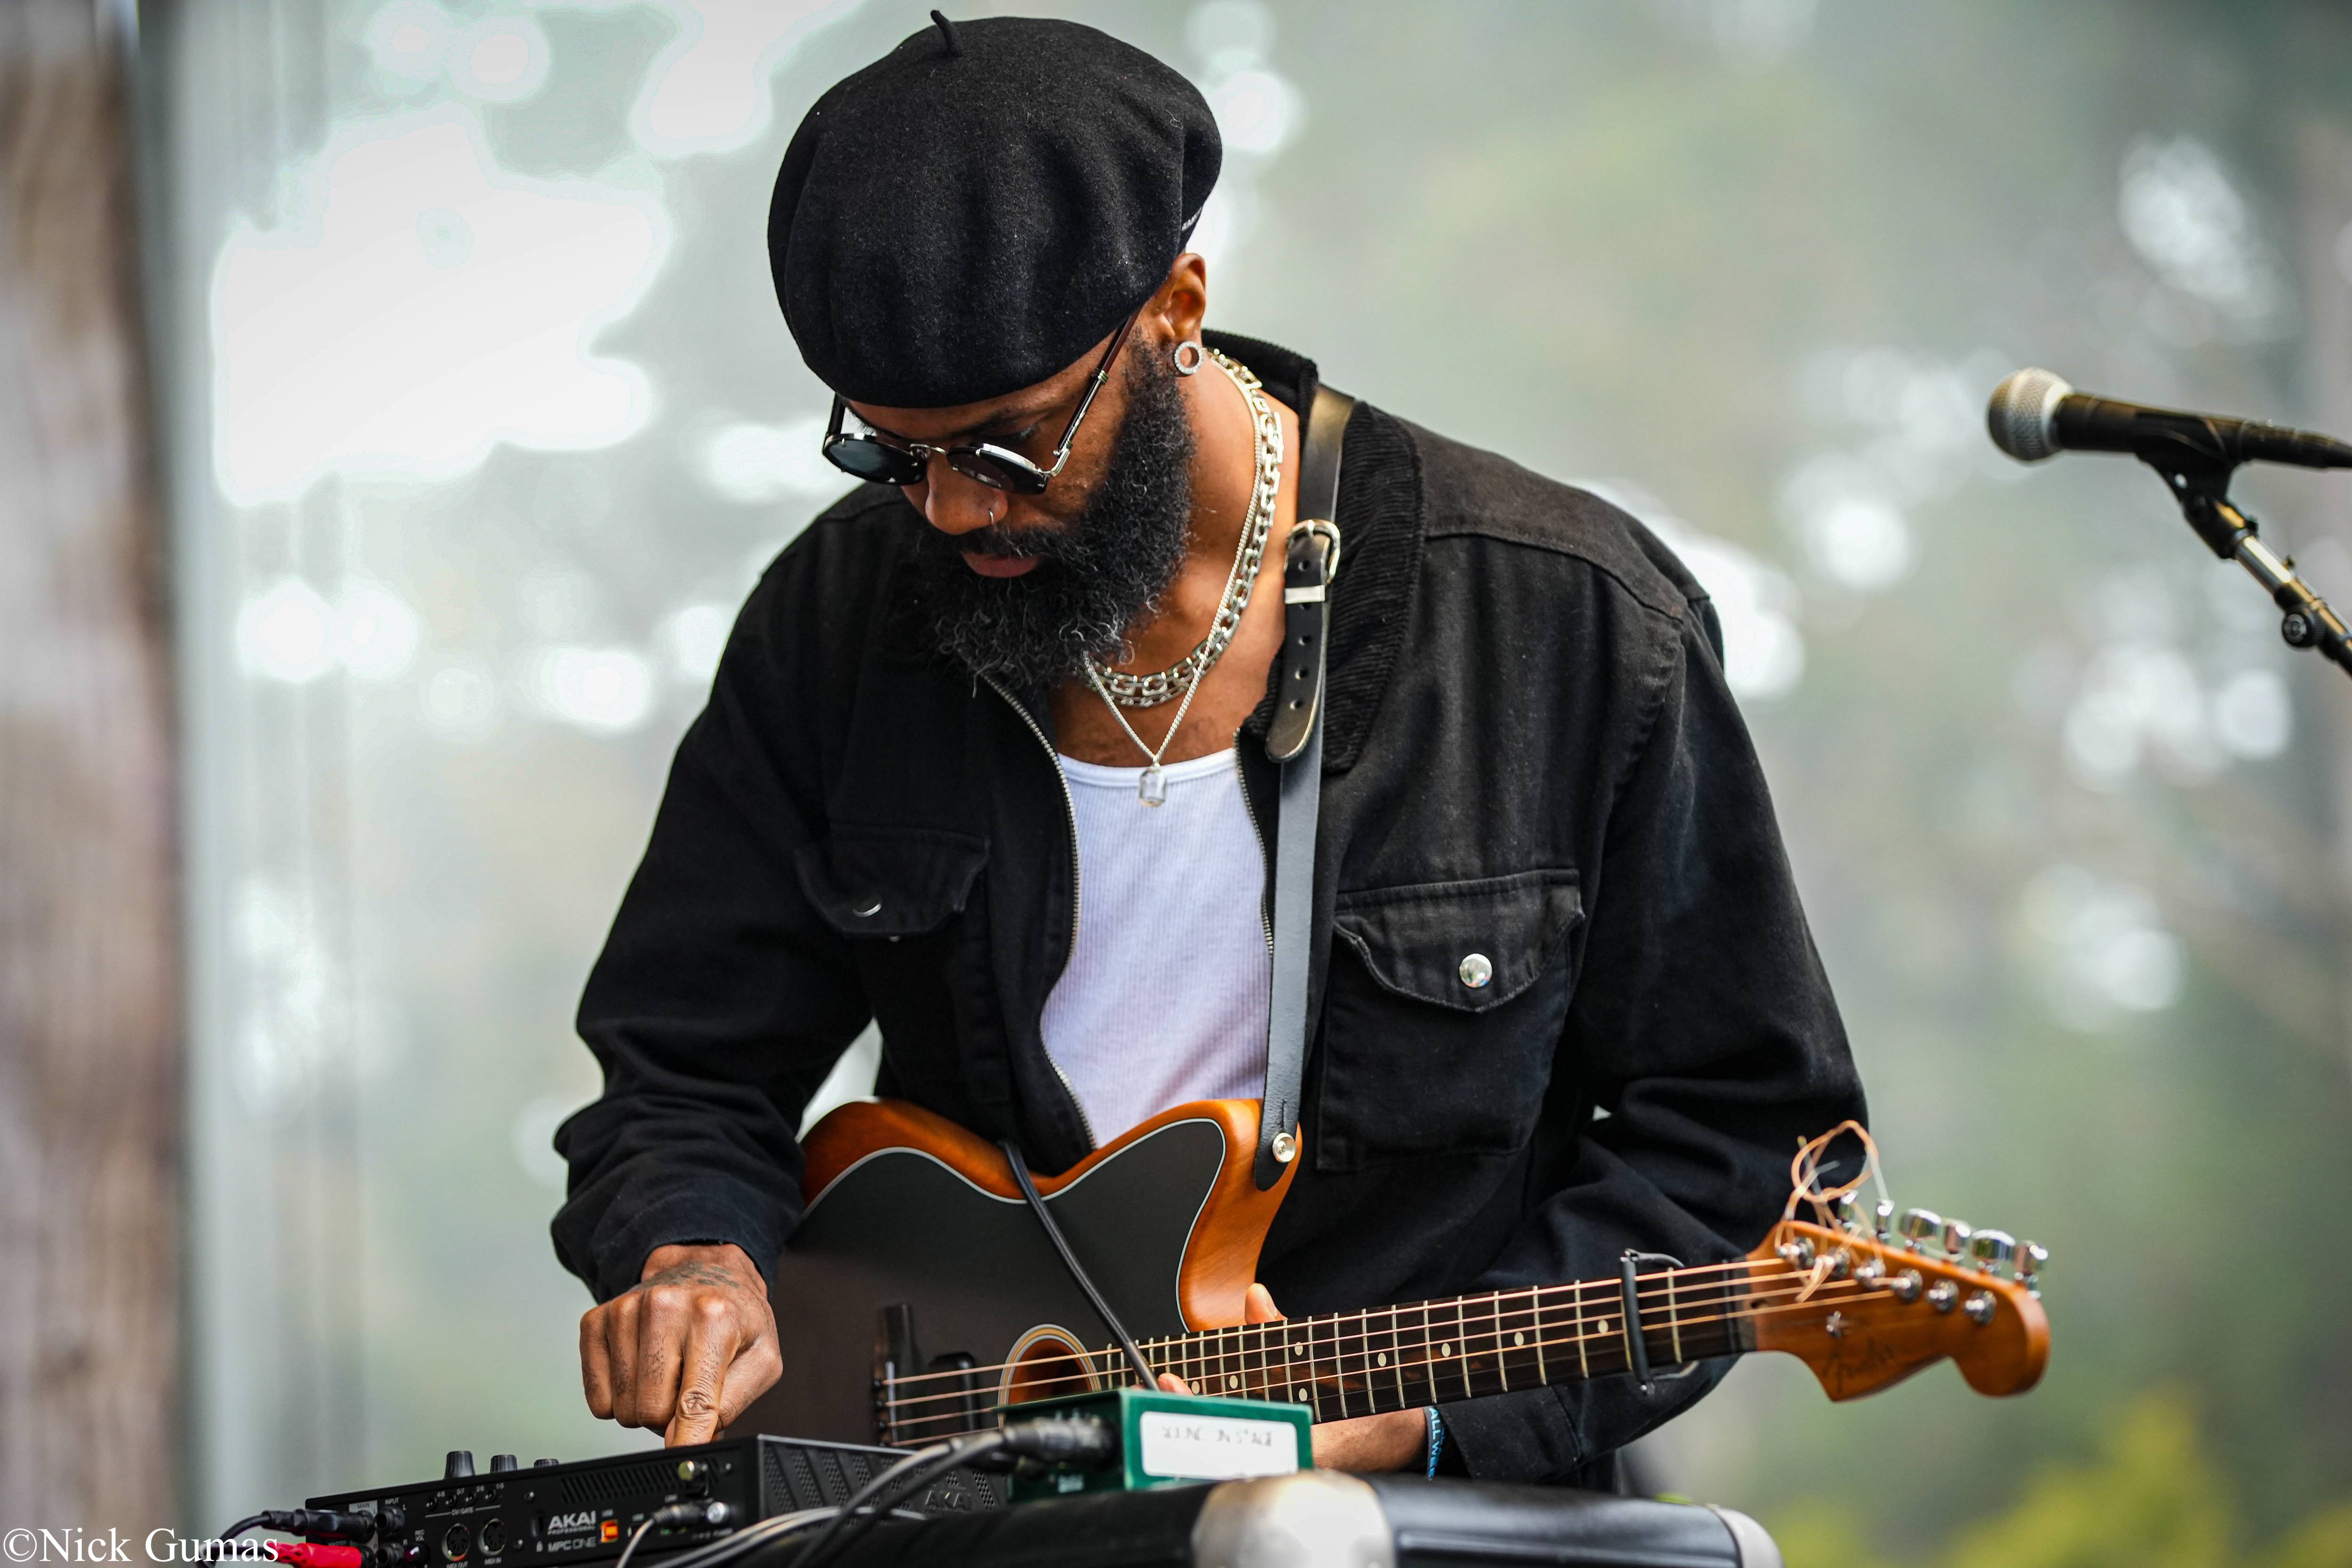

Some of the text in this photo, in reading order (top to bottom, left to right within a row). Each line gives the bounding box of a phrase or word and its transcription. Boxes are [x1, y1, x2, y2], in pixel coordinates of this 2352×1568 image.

[1429, 1407, 1441, 1441] ALL
[548, 1510, 596, 1530] AKAI
[548, 1536, 596, 1552] MPC ONE
